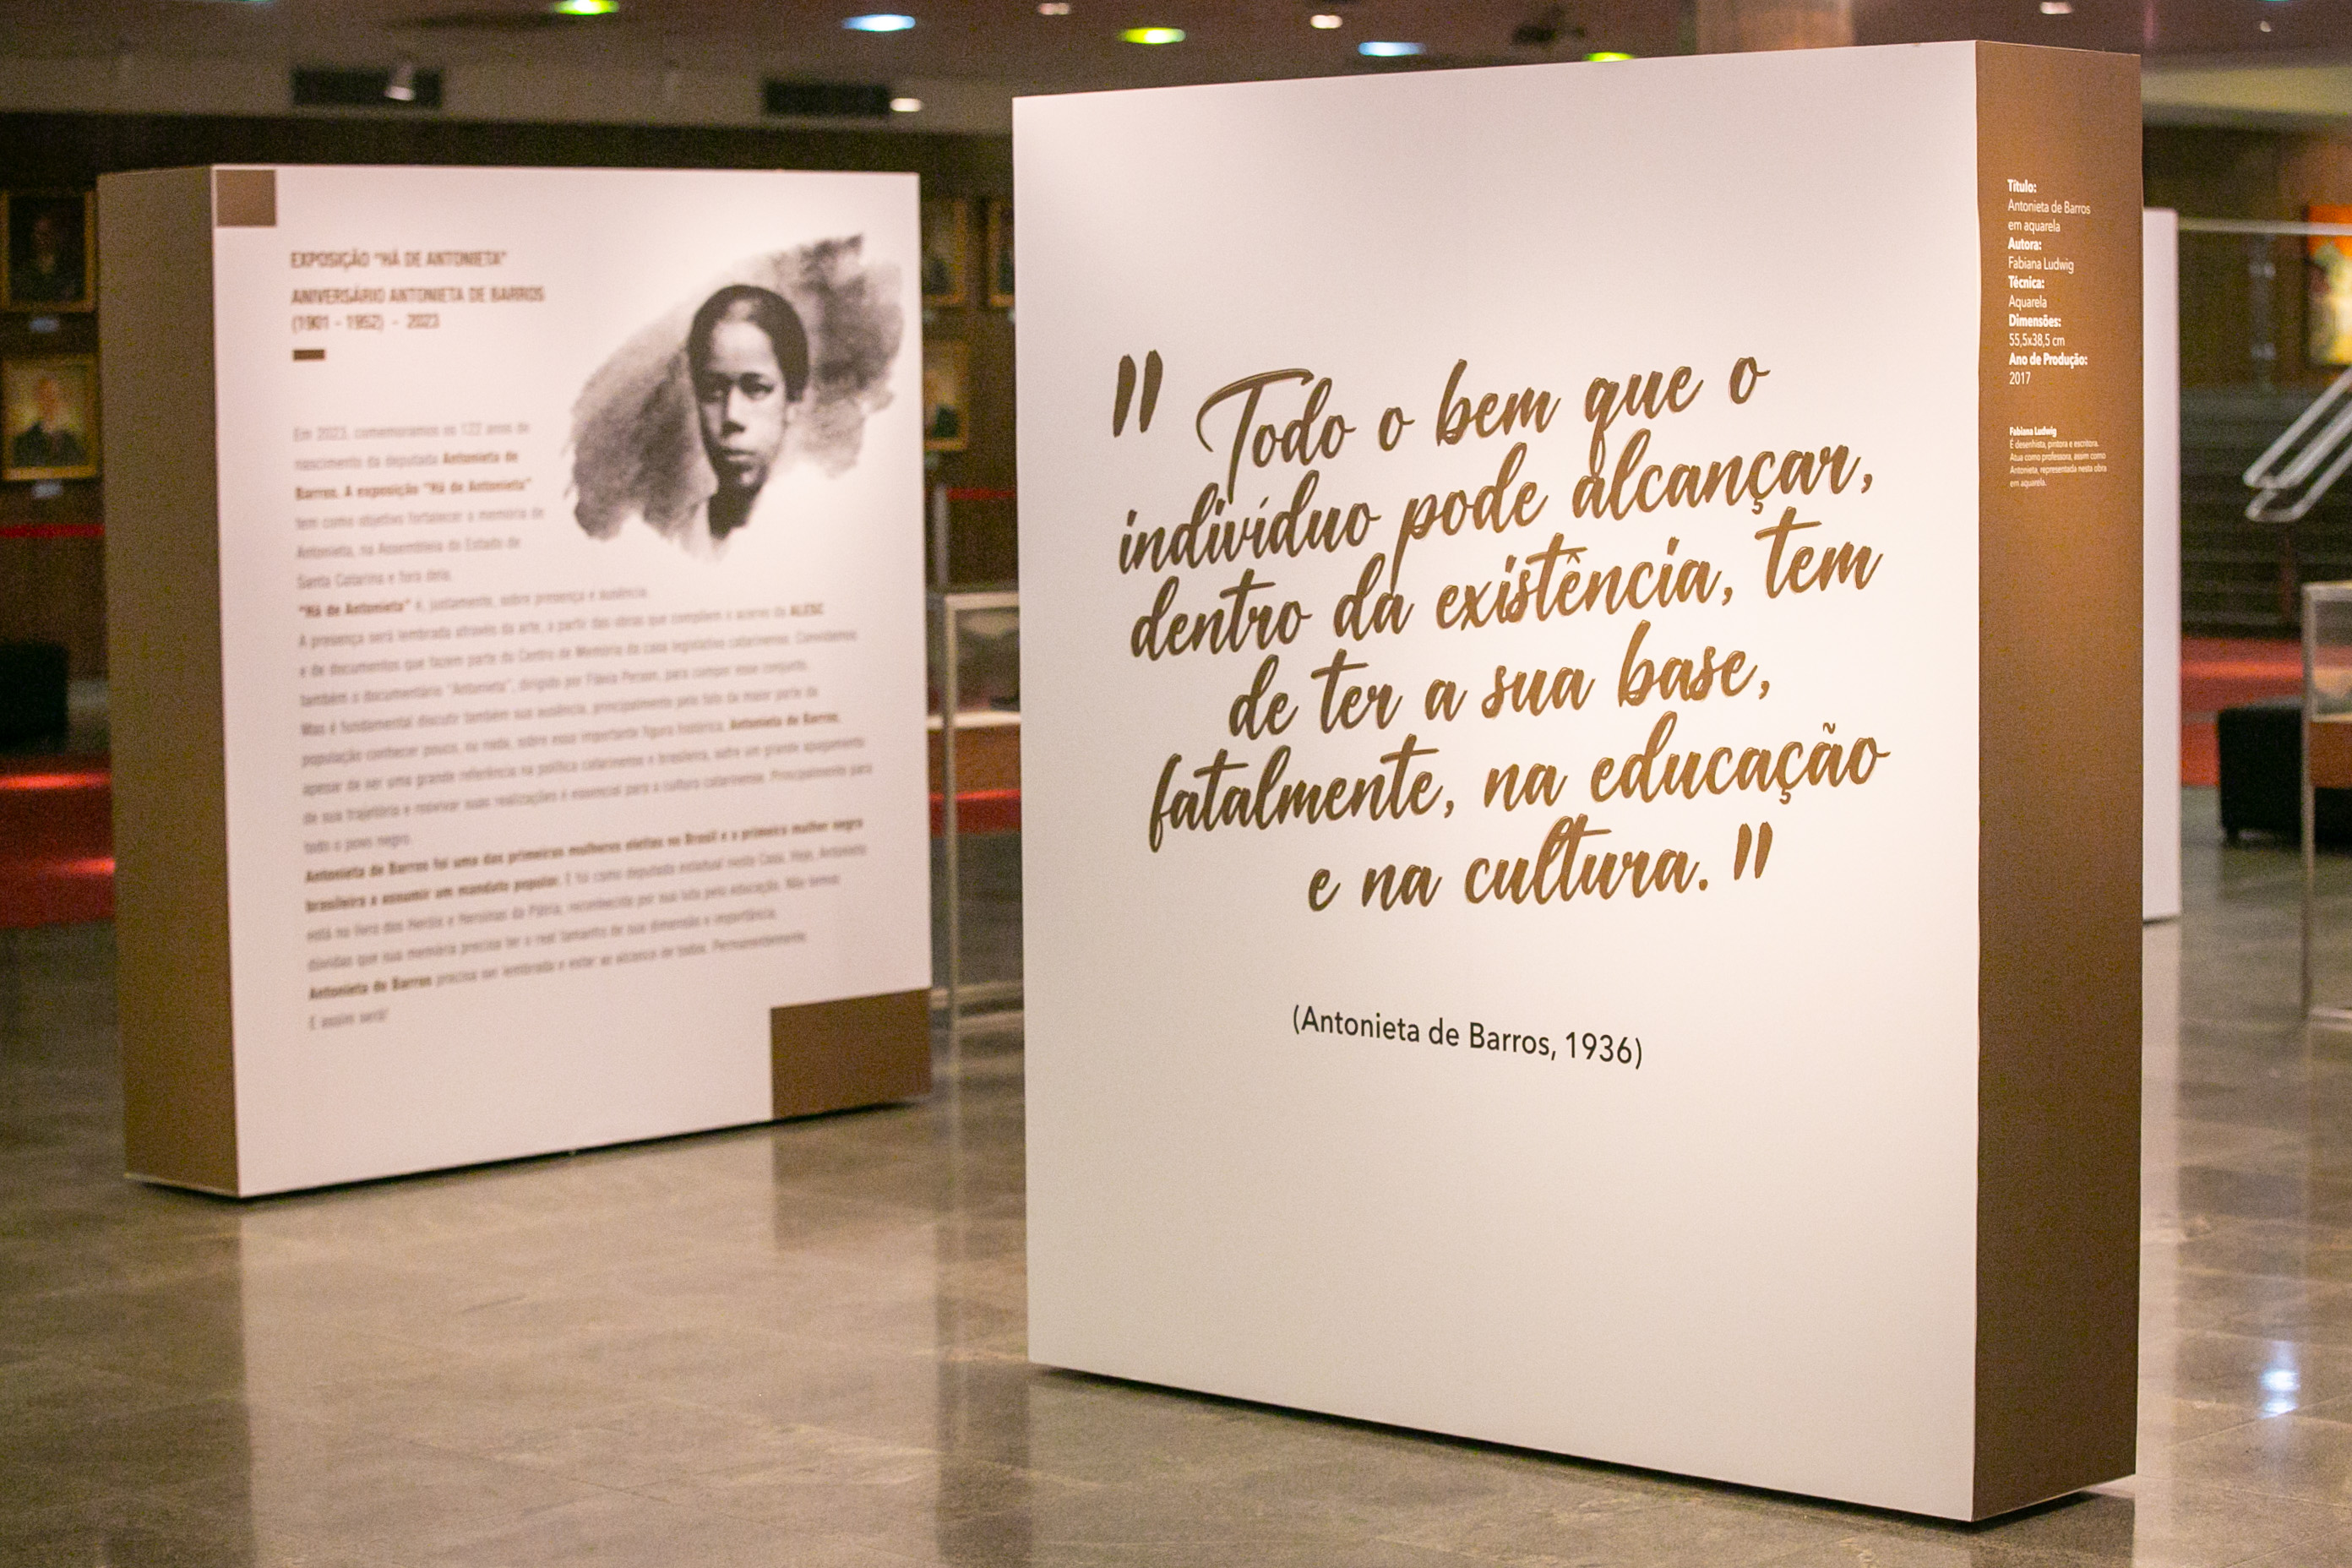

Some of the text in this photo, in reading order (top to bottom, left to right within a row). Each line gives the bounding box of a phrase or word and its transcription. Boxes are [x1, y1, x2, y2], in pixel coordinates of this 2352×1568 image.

[2007, 179, 2037, 193] Título:
[2007, 199, 2091, 215] Antonieta de Barros
[2008, 219, 2061, 235] em aquarela
[2007, 237, 2042, 251] Autora:
[2008, 256, 2074, 275] Fabiana Ludwig
[2008, 275, 2044, 289] Técnica:
[2008, 295, 2047, 311] Aquarela
[2009, 313, 2061, 328] Dimensões:
[2009, 333, 2066, 348] 55,5x38,5 cm
[2009, 352, 2088, 369] Ano de Produção:
[2009, 372, 2031, 385] 2017
[1195, 368, 1358, 505] Todo
[1378, 406, 1416, 452] o
[1435, 358, 1562, 447] bem
[1584, 365, 1702, 478] que
[1729, 356, 1771, 405] o
[2009, 426, 2057, 438] Fabiana Ludwig
[1119, 427, 1874, 595] indivíduo pode alcançar,
[1130, 506, 1884, 662] dentro da existência, tem
[1228, 619, 1770, 741] de ter a sua base,
[1148, 710, 1892, 853] fatalmente, na educação
[1308, 868, 1342, 912] e
[1361, 863, 1443, 912] na
[1293, 1004, 1643, 1070] (Antonieta de Barros, 1936)
